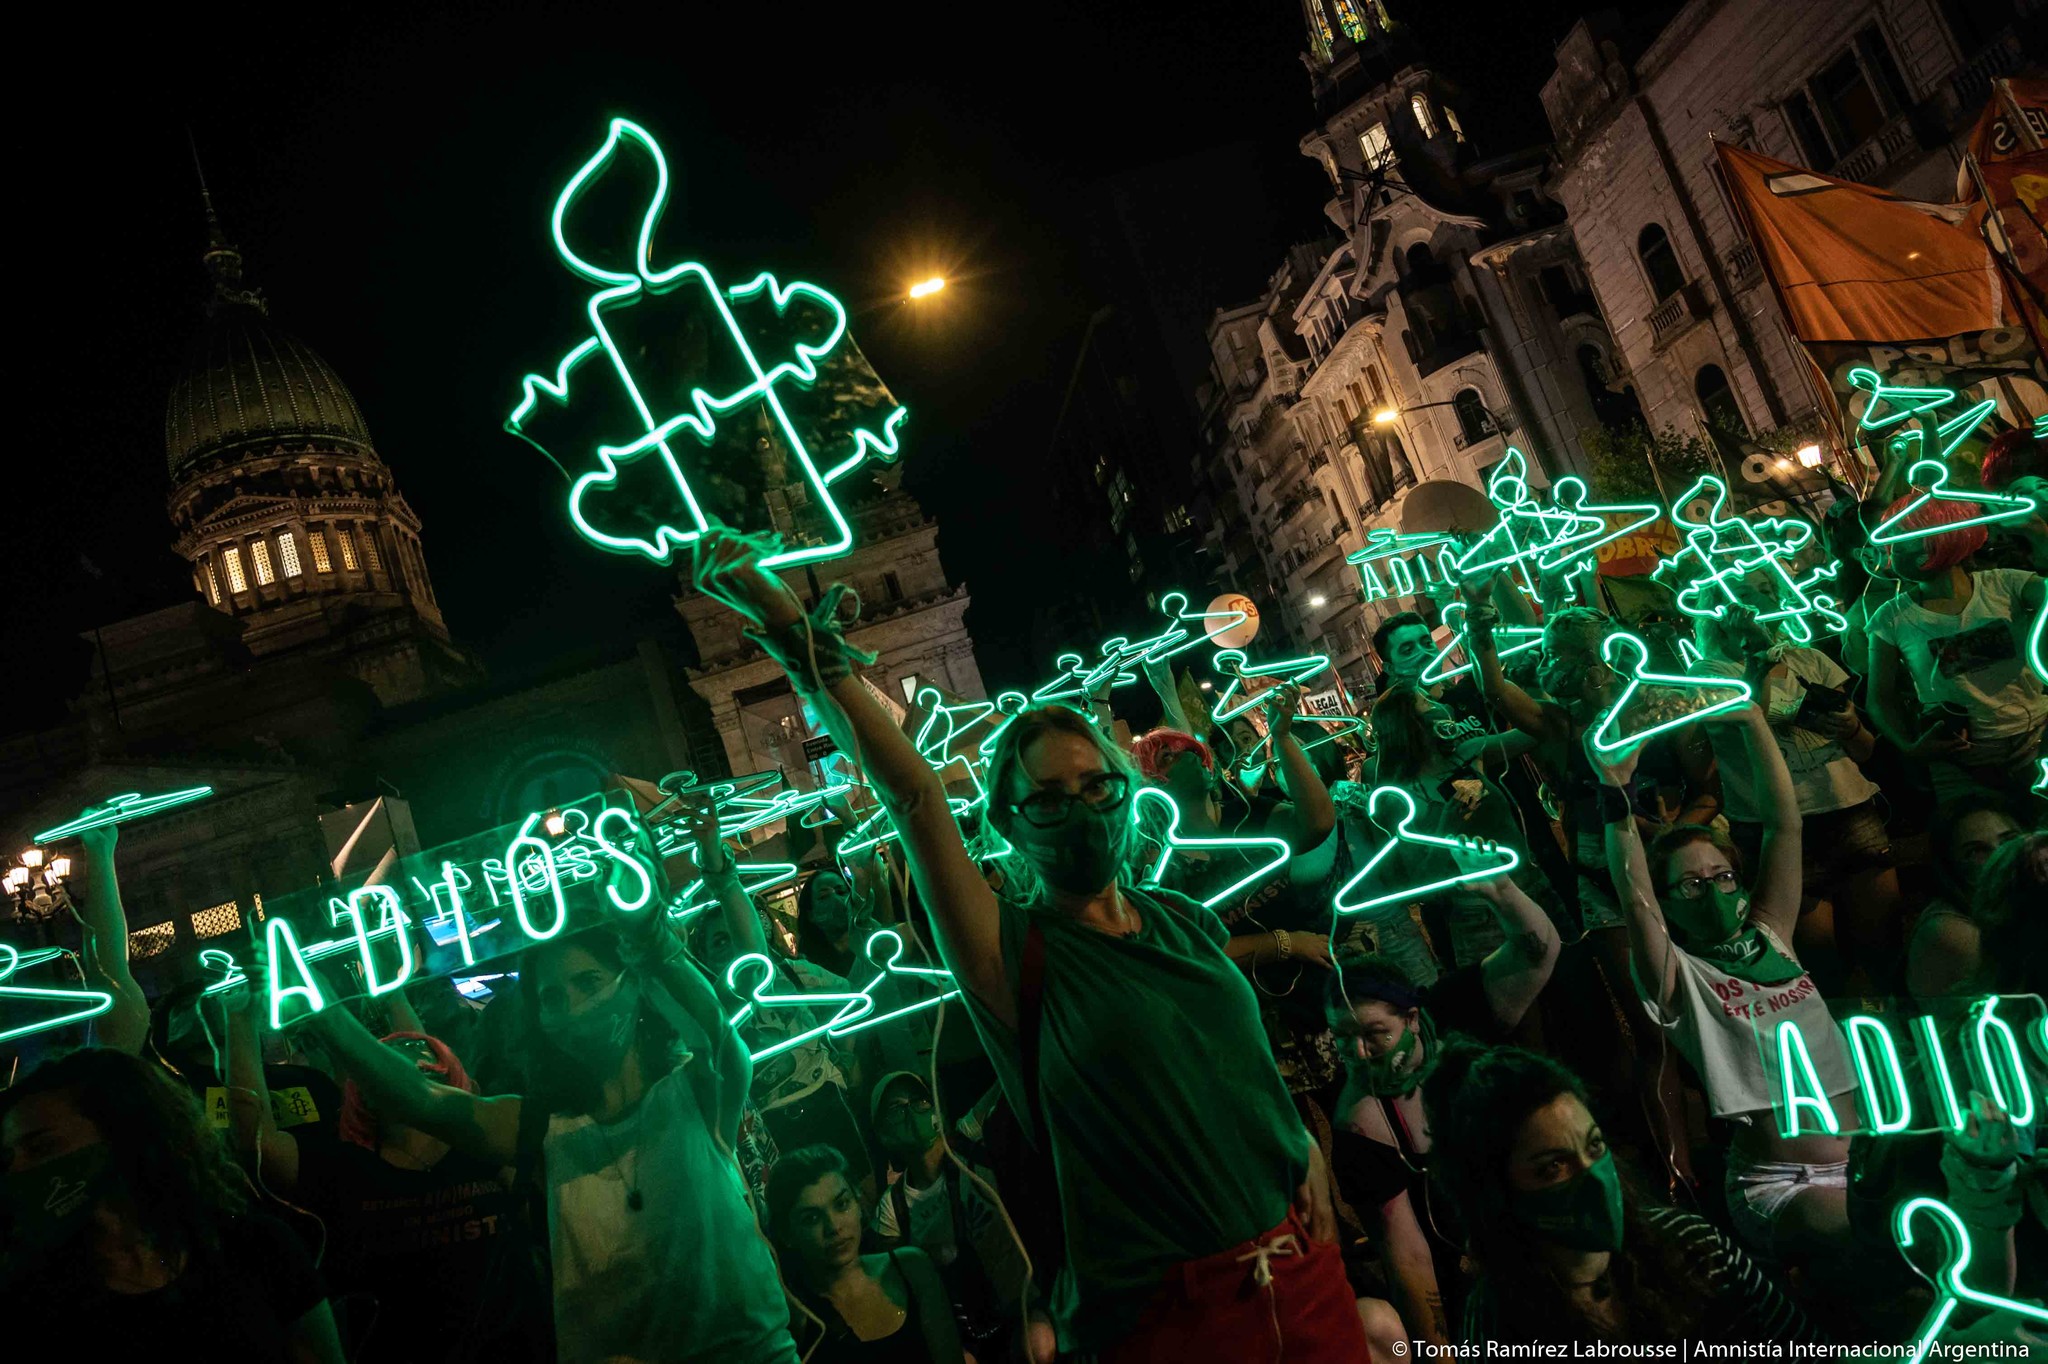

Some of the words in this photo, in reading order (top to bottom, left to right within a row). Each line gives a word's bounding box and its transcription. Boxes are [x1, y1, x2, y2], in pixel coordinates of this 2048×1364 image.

[1309, 694, 1339, 711] LEGAL
[266, 807, 651, 1030] ADIÓS
[1776, 995, 2048, 1137] ADIÓ
